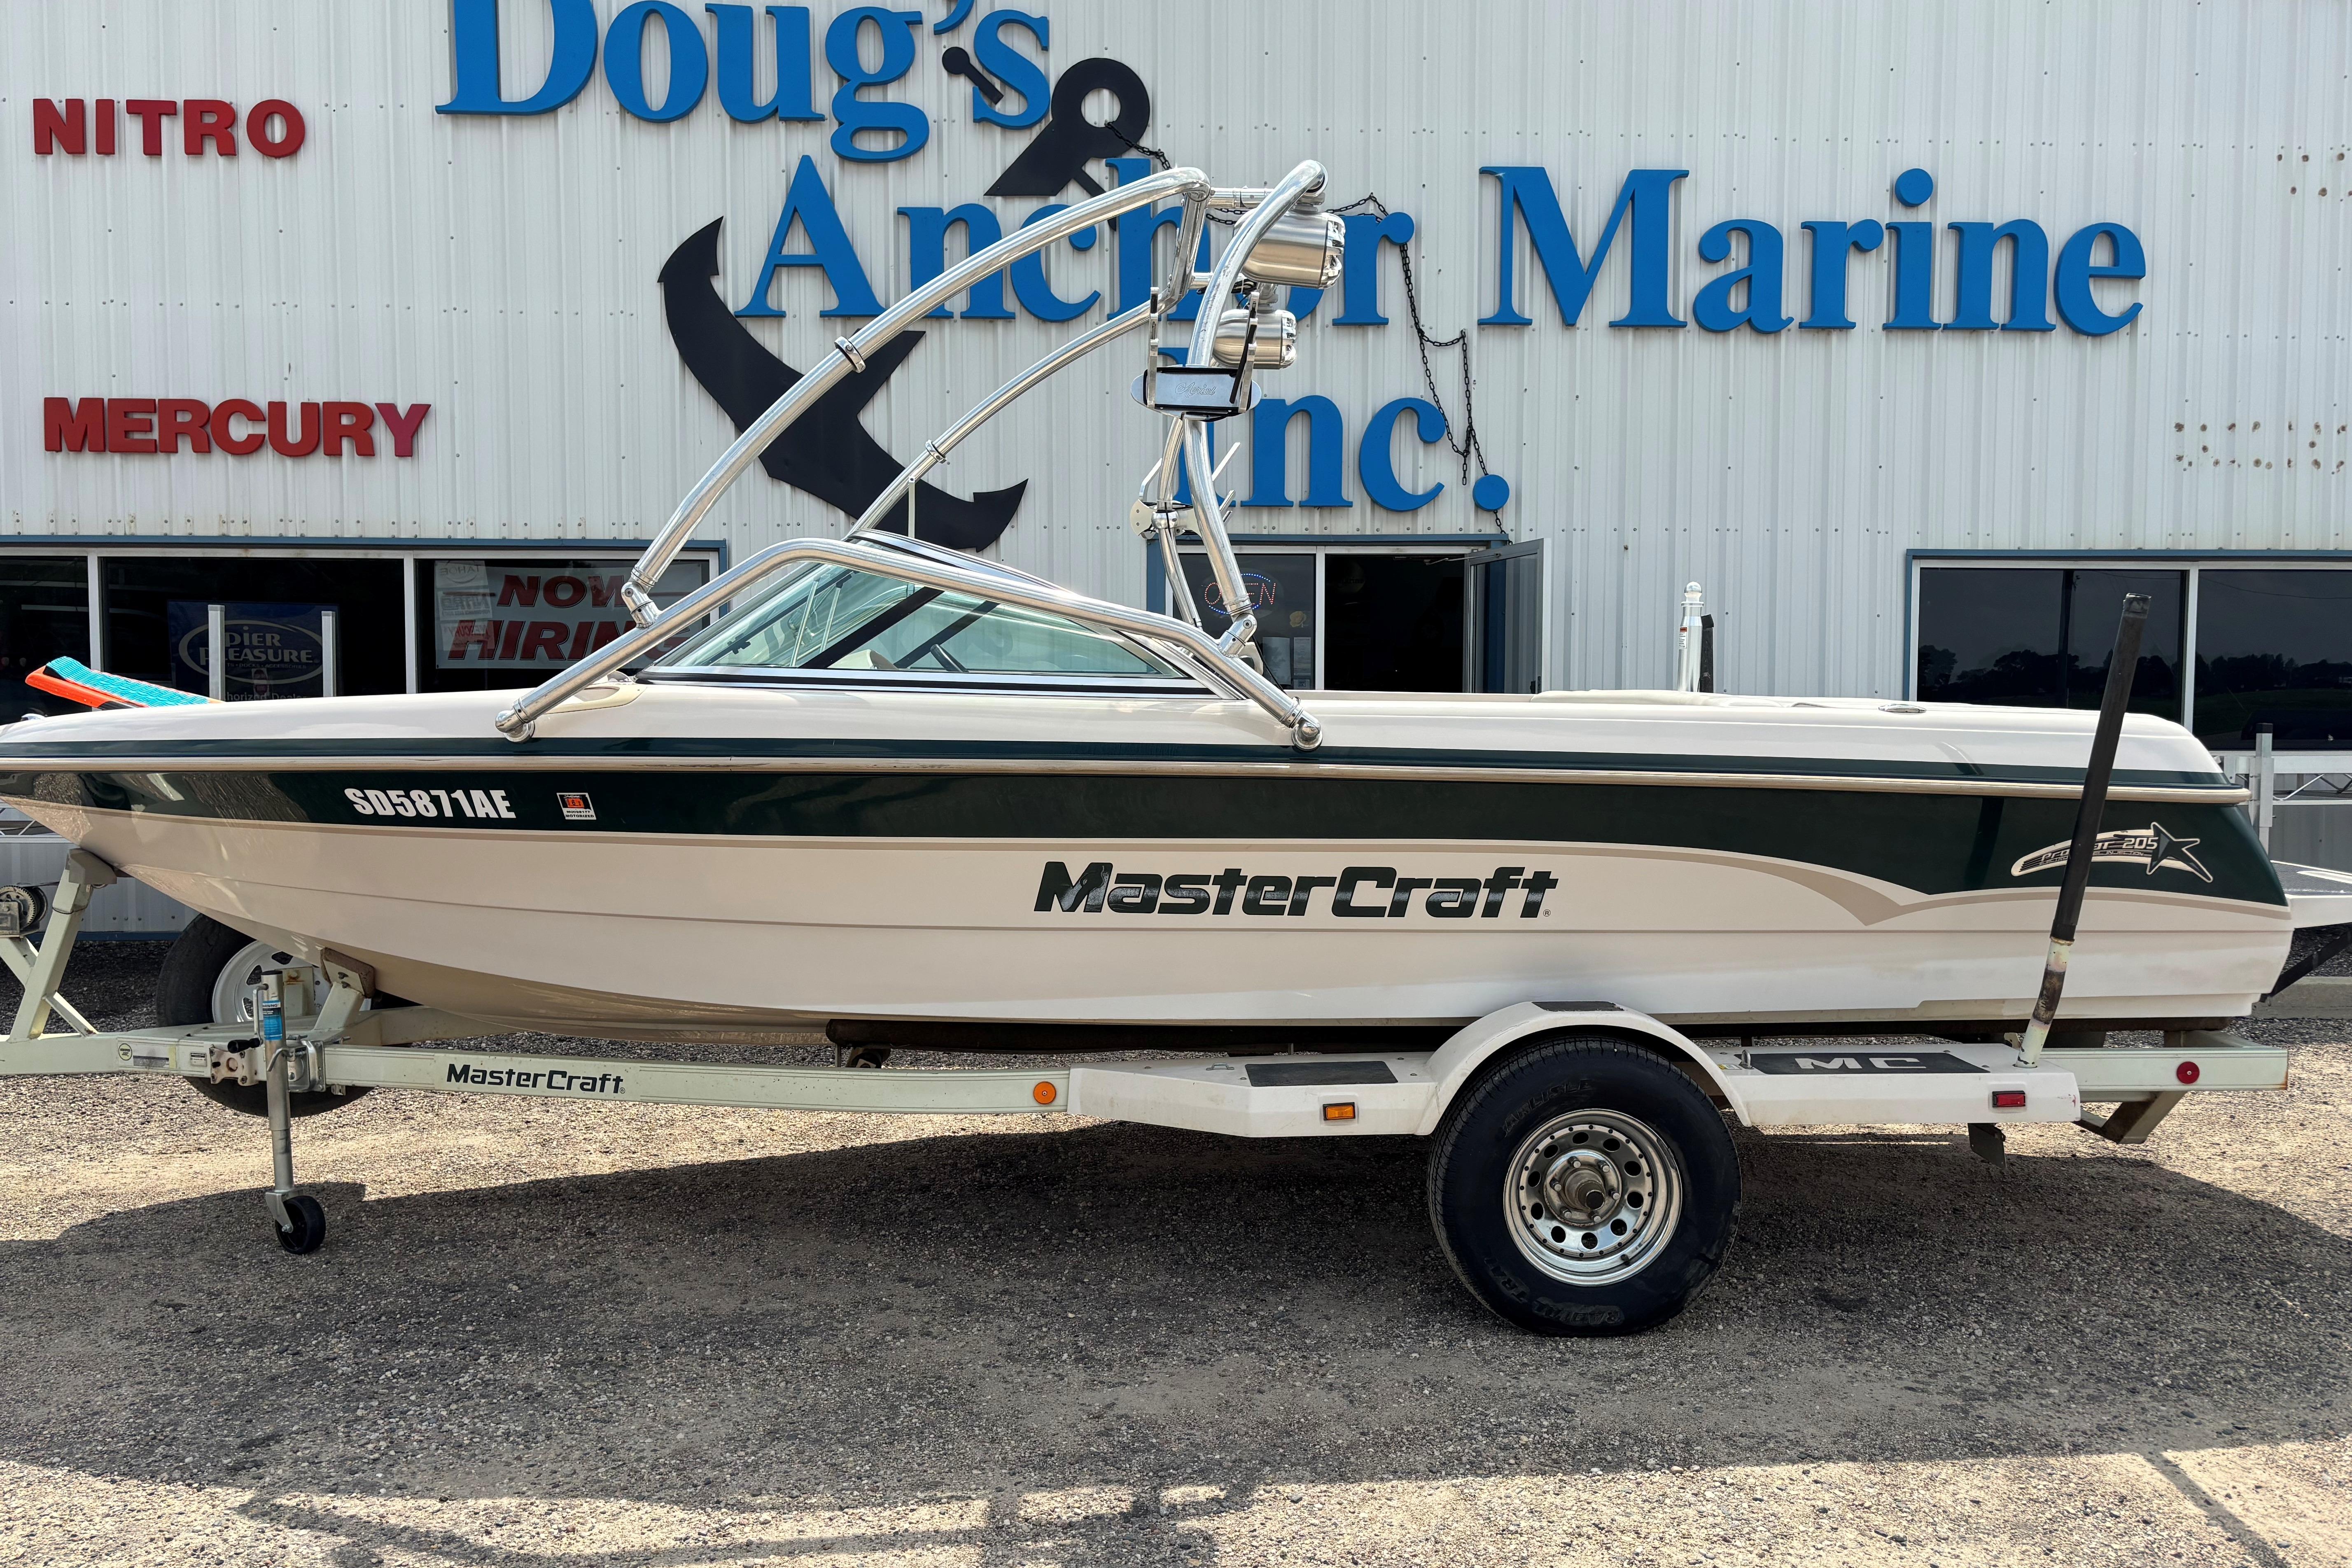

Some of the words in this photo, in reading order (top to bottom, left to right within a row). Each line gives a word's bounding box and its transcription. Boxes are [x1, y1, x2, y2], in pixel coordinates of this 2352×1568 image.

[435, 0, 1051, 163] Doug's
[33, 98, 306, 159] NITRO
[735, 155, 1414, 325] Anchr
[1478, 166, 2146, 337] Marine
[1175, 382, 1216, 398] Aerial
[44, 397, 431, 457] MERCURY
[497, 575, 631, 608] NOW
[1204, 582, 1276, 605] OEN
[199, 647, 313, 665] PEASURE
[344, 788, 516, 819] SD5871AE
[2122, 837, 2159, 849] 205
[1034, 861, 1559, 918] MasterCraft
[447, 1064, 624, 1094] MasterCraft
[1794, 1058, 1927, 1069] MC
